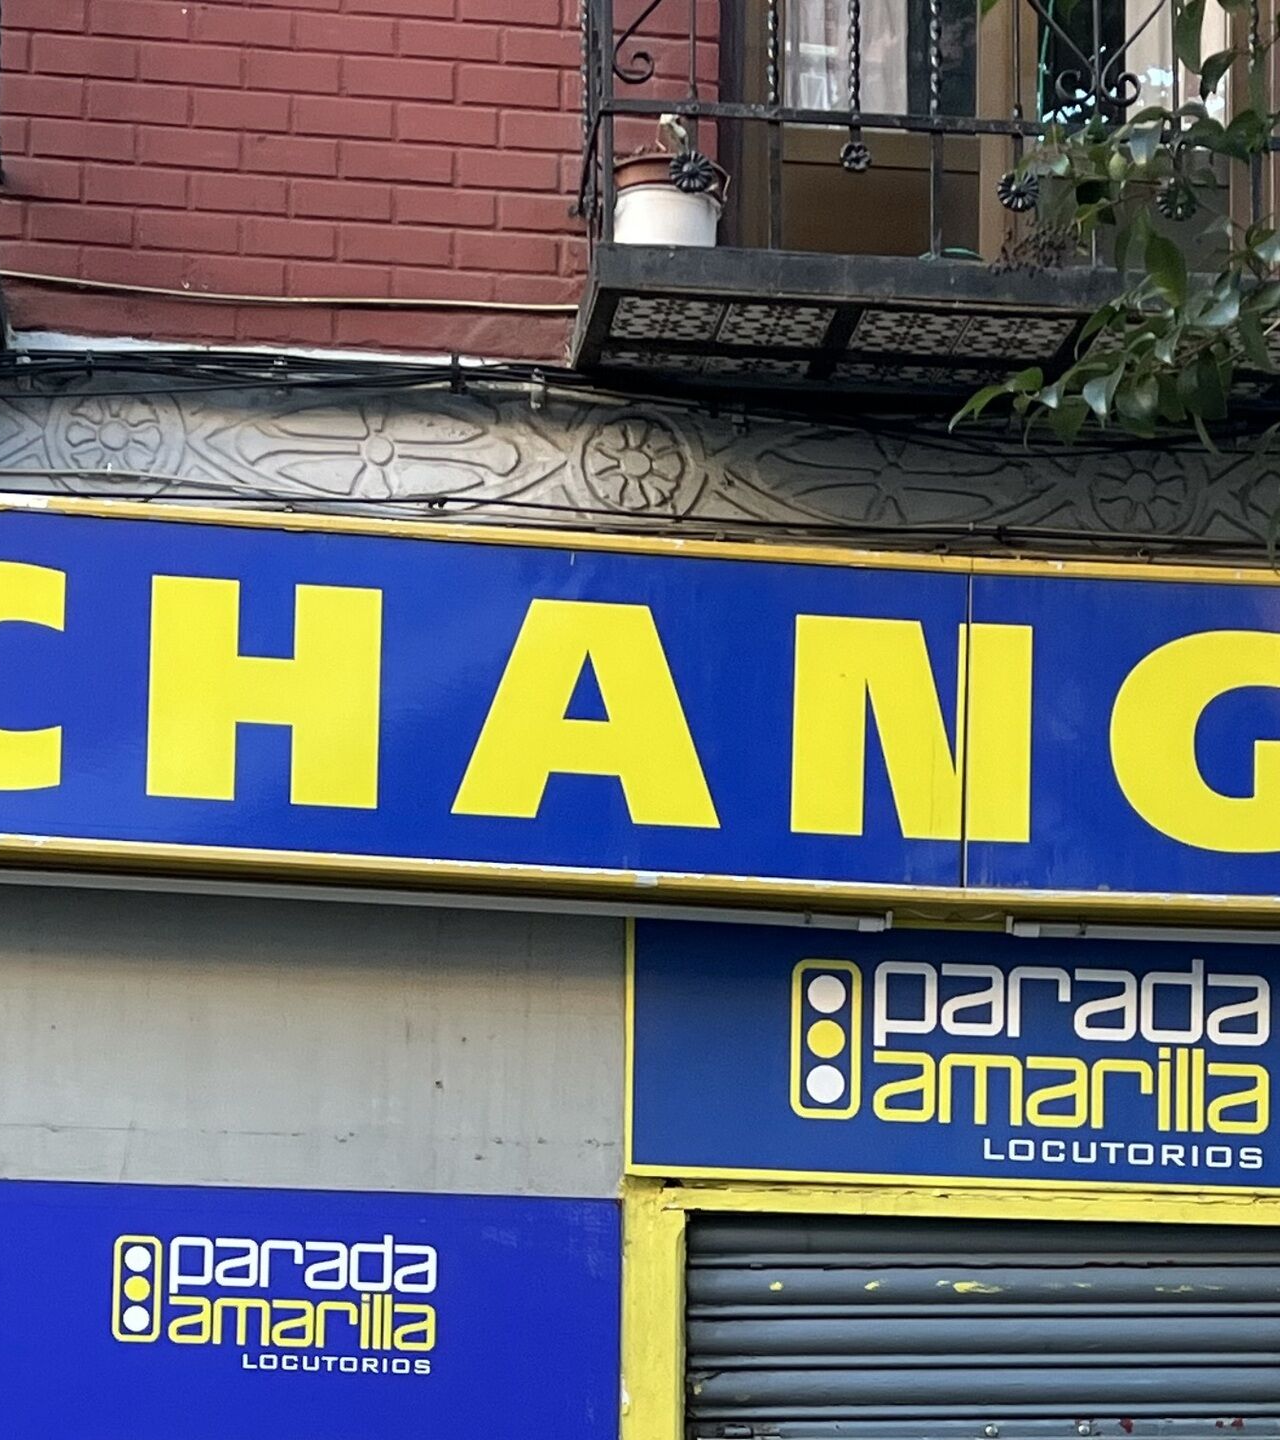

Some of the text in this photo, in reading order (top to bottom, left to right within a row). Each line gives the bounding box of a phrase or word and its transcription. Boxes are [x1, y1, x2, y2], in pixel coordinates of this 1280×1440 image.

[873, 958, 1271, 1048] parada
[872, 1046, 1270, 1135] amarilla
[983, 1138, 1264, 1170] LOCUTORIOS
[169, 1234, 437, 1293] parada
[168, 1292, 436, 1352] amarilla
[242, 1353, 431, 1375] LOCUTORIOS
